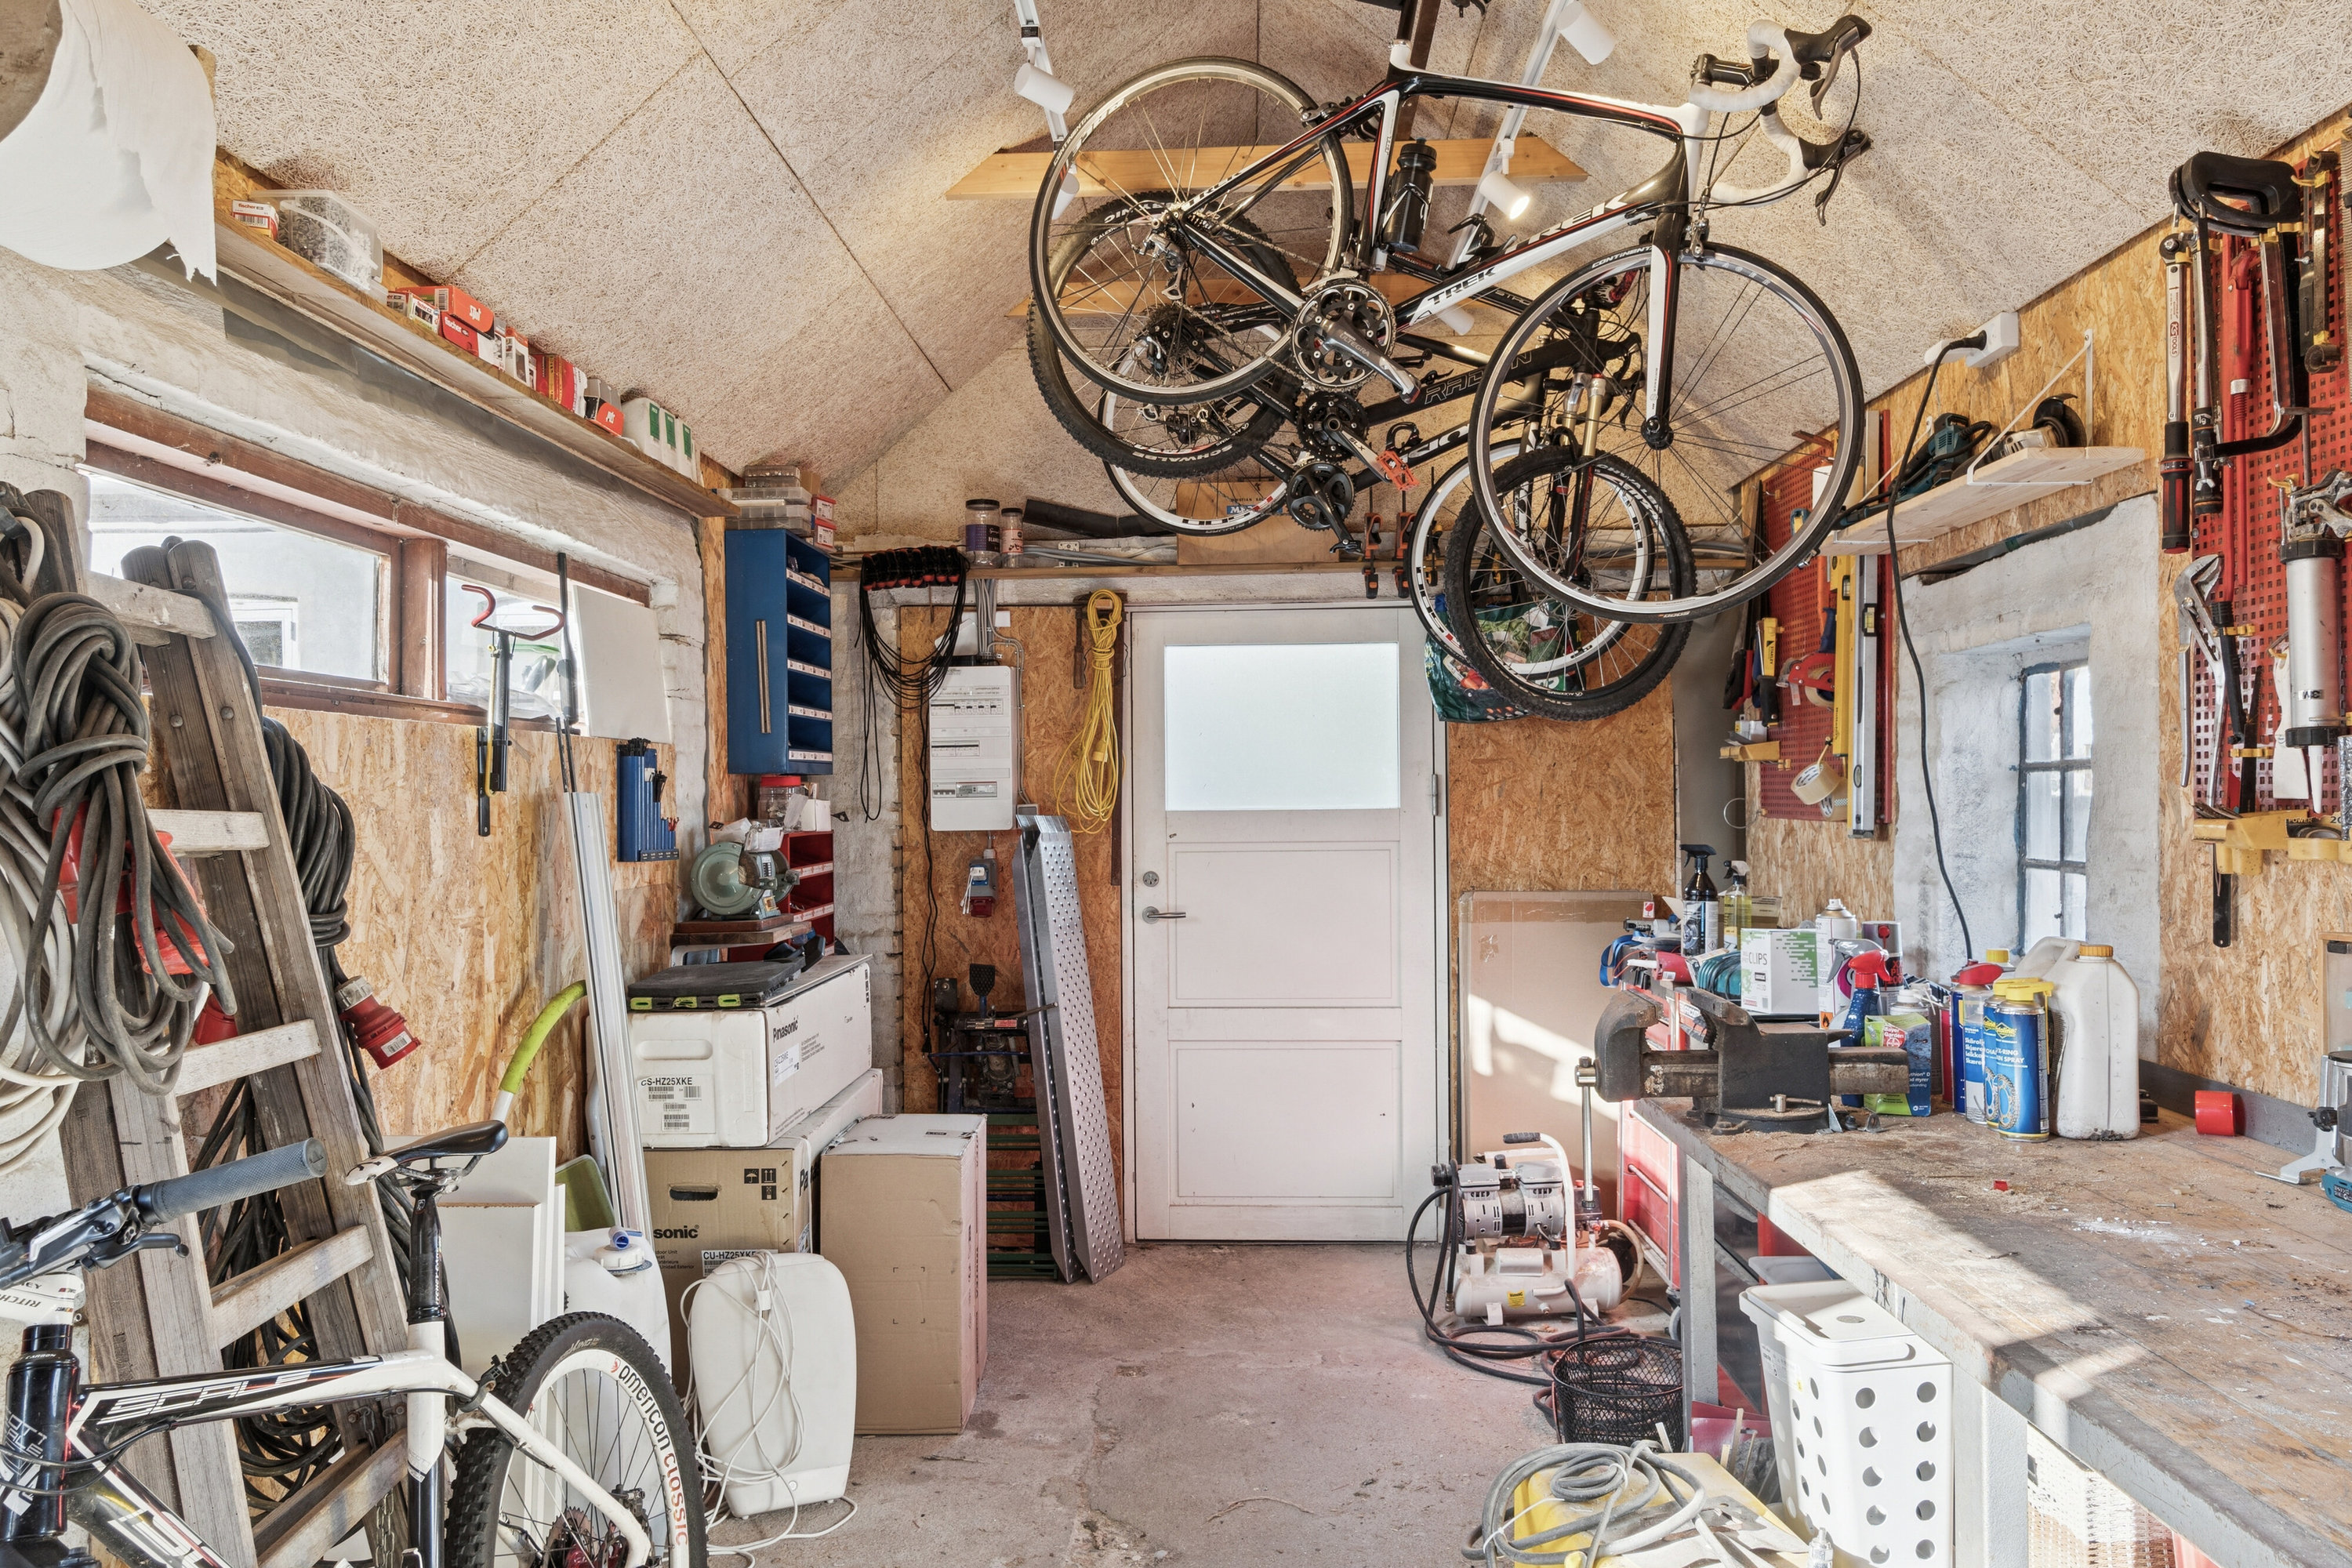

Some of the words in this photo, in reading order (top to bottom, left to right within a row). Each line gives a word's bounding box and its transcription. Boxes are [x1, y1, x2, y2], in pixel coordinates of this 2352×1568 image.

[1053, 111, 1094, 166] CONTINENTAL
[1592, 245, 1653, 268] CONTINENT
[1427, 267, 1497, 306] TREK
[416, 300, 427, 310] fischer
[444, 316, 463, 333] fischer
[1339, 333, 1370, 358] ULTEGRA
[1425, 352, 1532, 405] RADN
[1132, 444, 1233, 463] SCHWALBE
[1348, 437, 1366, 451] SLX
[1596, 463, 1663, 514] CHWALBE
[1748, 952, 1768, 965] CLIPS
[641, 1076, 693, 1087] CS-HZ25XKE
[653, 1225, 699, 1239] sonic
[0, 1294, 42, 1308] RITCH
[97, 1370, 312, 1425] SCALE
